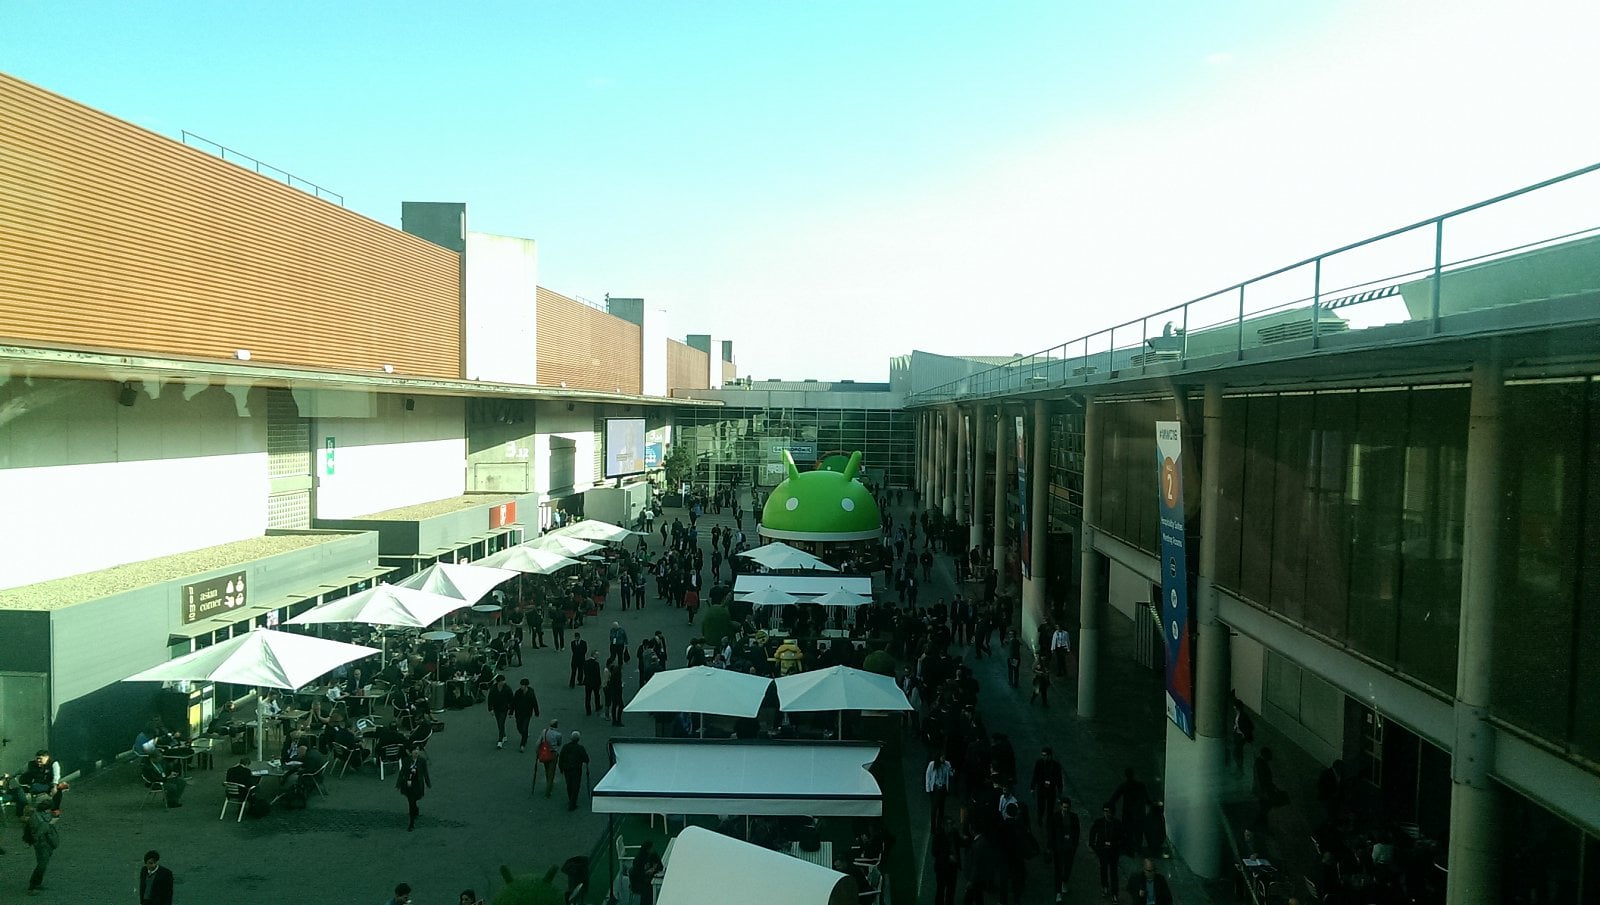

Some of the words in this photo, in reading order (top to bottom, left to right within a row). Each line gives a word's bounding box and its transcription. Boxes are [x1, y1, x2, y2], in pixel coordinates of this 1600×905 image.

[1167, 473, 1173, 500] 2
[200, 588, 217, 600] asian
[200, 598, 222, 611] corner
